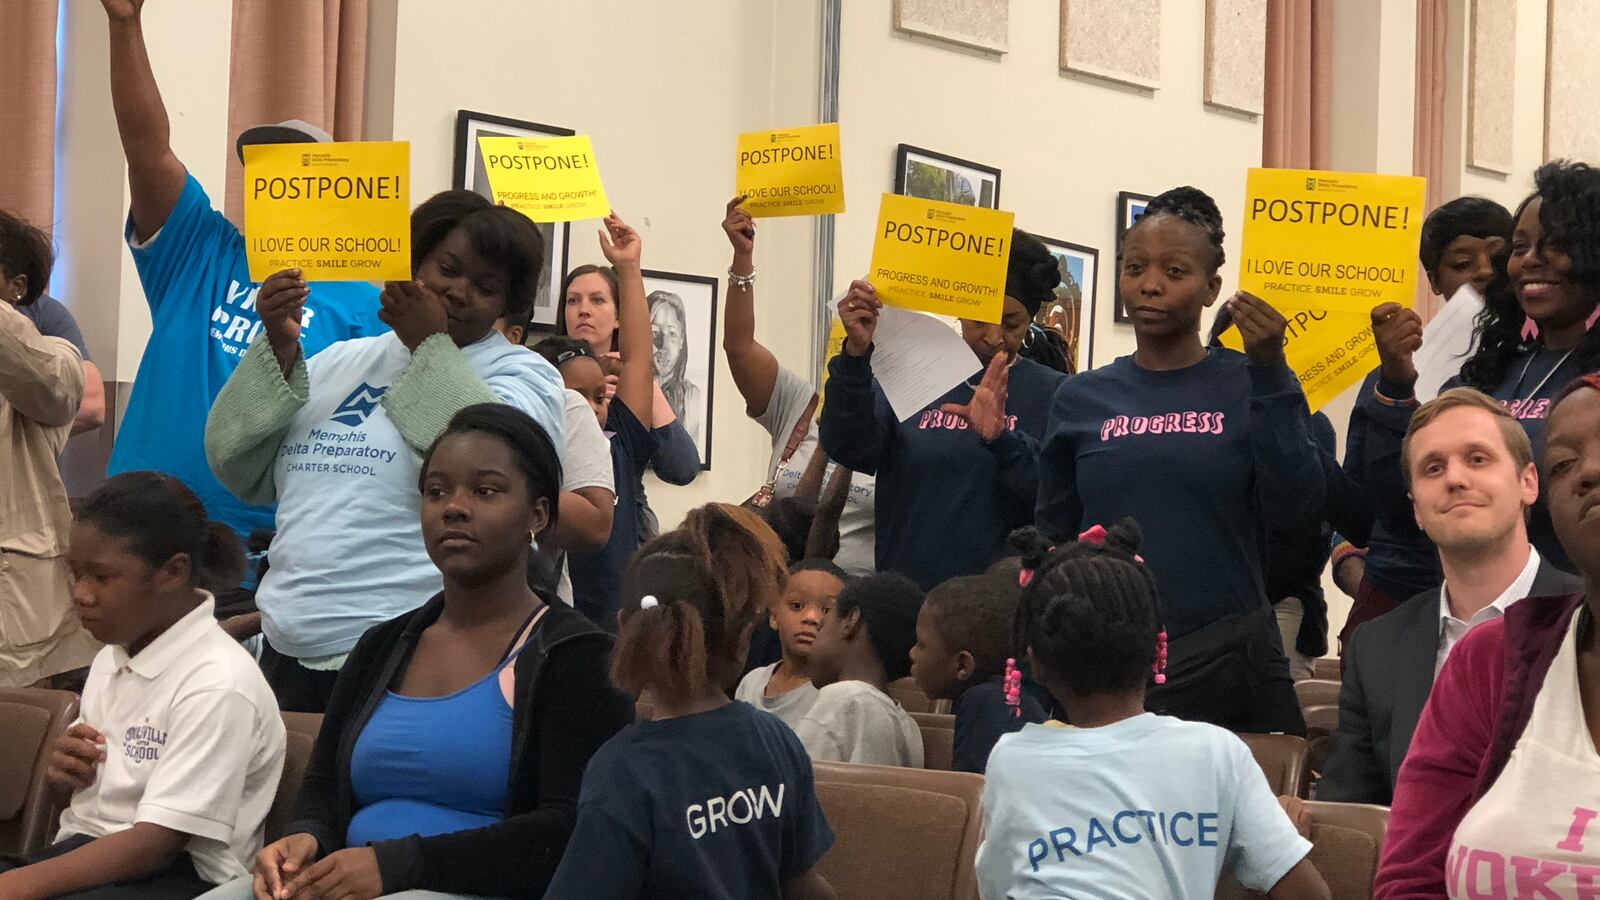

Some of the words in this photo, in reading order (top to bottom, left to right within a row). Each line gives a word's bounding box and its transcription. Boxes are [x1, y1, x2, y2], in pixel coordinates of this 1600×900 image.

[488, 153, 589, 170] POSTPONE!
[741, 143, 833, 166] POSTPONE!
[254, 176, 400, 199] POSTPONE!
[497, 191, 540, 201] PROGRESS
[541, 192, 558, 201] AND
[769, 186, 791, 198] OUR
[793, 183, 836, 196] SCHOOL!
[1252, 198, 1409, 230] POSTPONE!
[253, 238, 257, 252] I
[259, 237, 294, 252] LOVE
[298, 237, 330, 252] OUR
[334, 237, 401, 252] SCHOOL!
[884, 220, 1004, 258] POSTPONE!
[269, 259, 313, 268] PRACTICE
[316, 259, 348, 268] SMILE
[350, 259, 382, 268] GROW
[1247, 258, 1251, 273] I
[1255, 259, 1294, 276] LOVE
[1298, 262, 1331, 279] OUR
[1335, 264, 1405, 284] SCHOOL!
[876, 268, 929, 287] PROGRESS
[930, 277, 951, 290] AND
[952, 281, 999, 297] GROWTH!
[1263, 281, 1312, 294] PRACTICE
[1315, 285, 1348, 296] SMILE
[1349, 287, 1383, 298] GROW
[928, 292, 955, 303] SMILE
[955, 296, 982, 307] GROW
[1298, 361, 1326, 385] RESS
[1325, 347, 1346, 368] AND
[1345, 326, 1375, 351] GROW
[1334, 356, 1359, 376] SMILE
[1358, 342, 1377, 358] GRO
[308, 429, 367, 443] Memphis
[1101, 411, 1226, 442] PROGRESS
[312, 442, 397, 464] Preparatory
[286, 463, 330, 473] CHARTER
[332, 463, 377, 477] SCHOOL
[782, 469, 802, 480] Delt
[686, 783, 785, 840] GROW
[1028, 810, 1218, 872] PRACTICE
[1556, 807, 1598, 852] I
